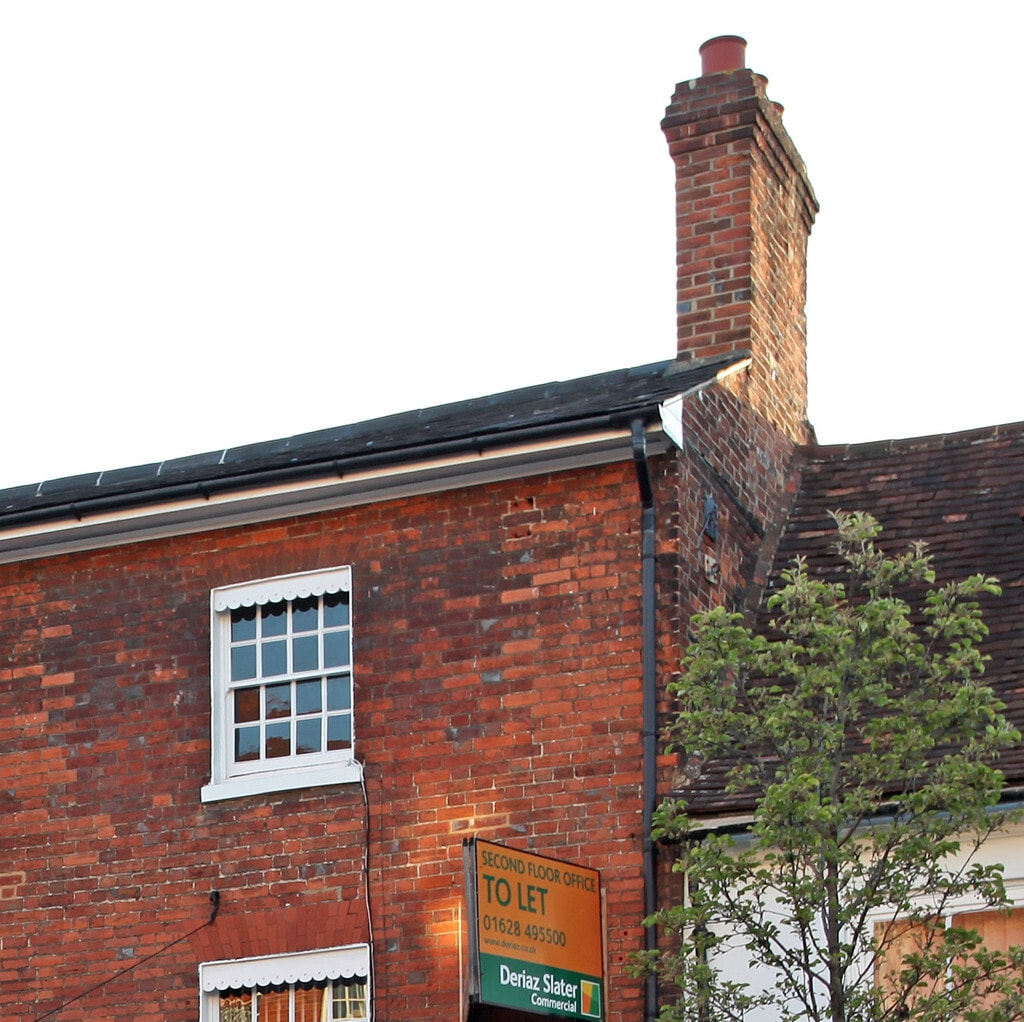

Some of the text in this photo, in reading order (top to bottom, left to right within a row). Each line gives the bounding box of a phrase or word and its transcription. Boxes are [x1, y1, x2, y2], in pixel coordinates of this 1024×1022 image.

[481, 850, 596, 893] SECOND FLOOR OFFICE
[482, 874, 548, 915] TO LET
[483, 915, 566, 947] 01628 495500
[484, 938, 536, 953] www.deriaz.co.uk
[500, 964, 578, 999] Deriaz Slater
[531, 992, 577, 1013] Commercial
